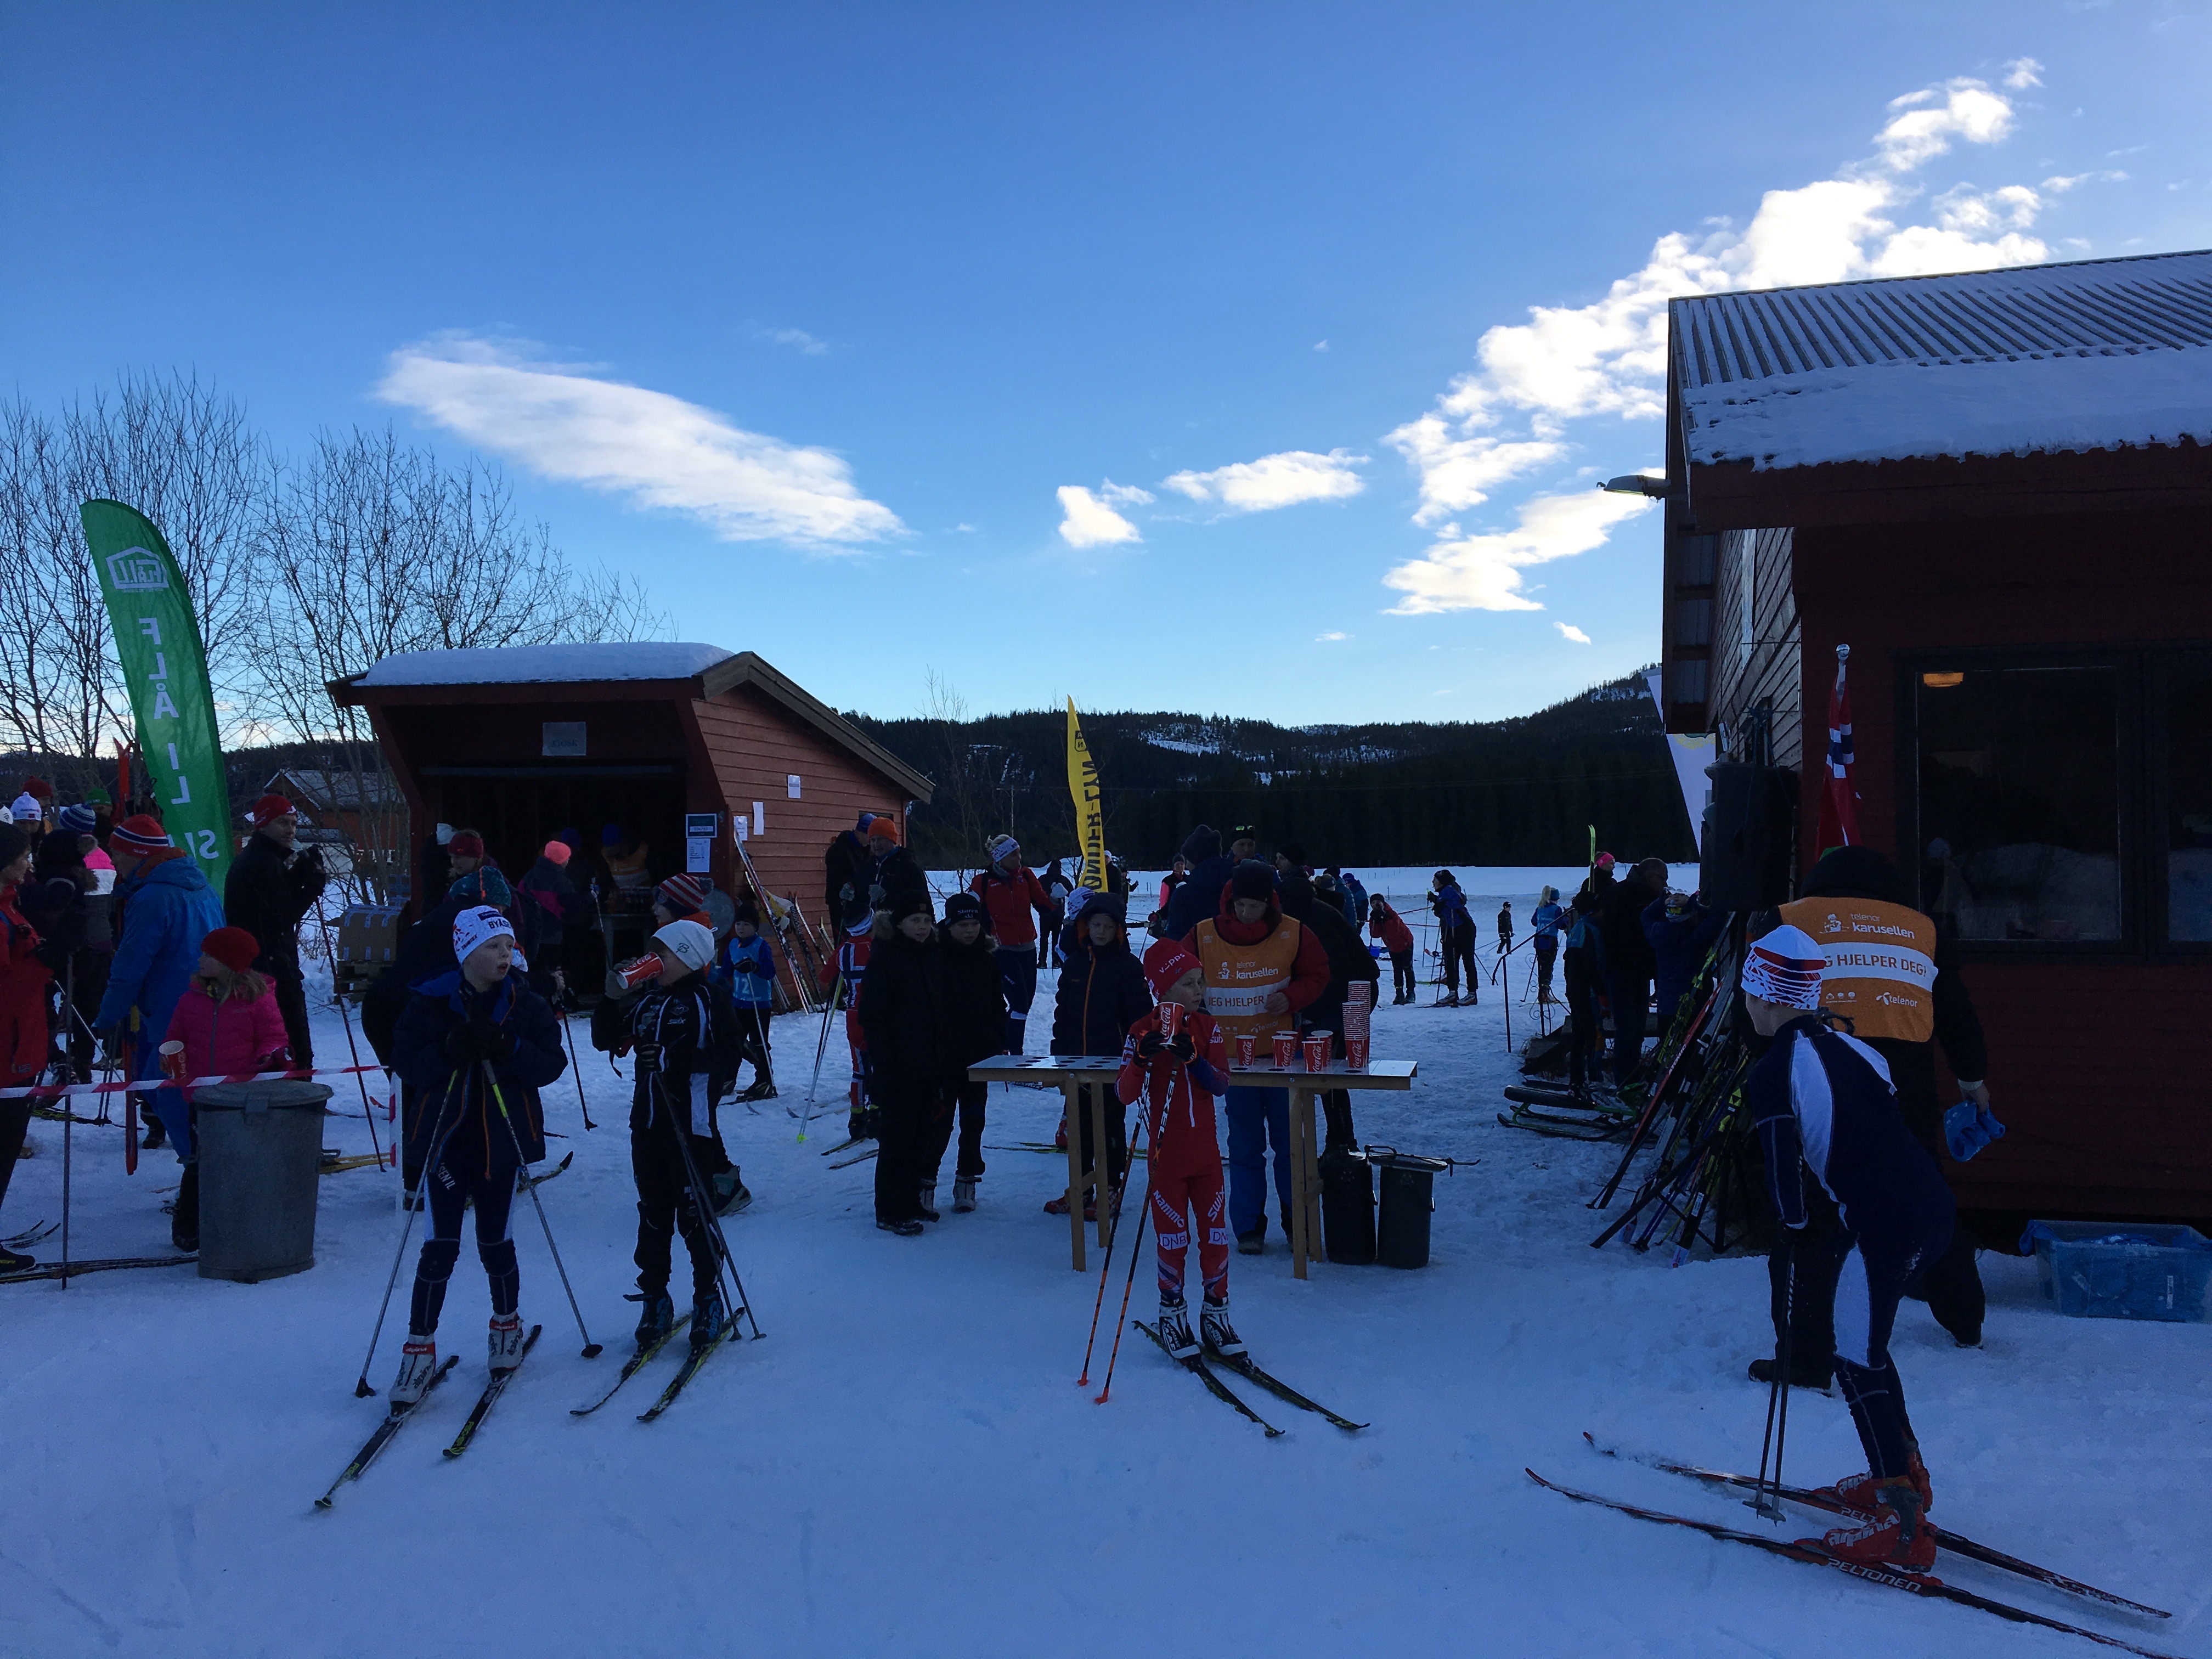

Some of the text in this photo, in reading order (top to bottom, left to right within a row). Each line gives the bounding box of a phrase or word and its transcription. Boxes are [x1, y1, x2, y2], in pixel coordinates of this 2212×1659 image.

[1850, 912, 1881, 922] telenor
[1852, 922, 1915, 939] karusellen
[1837, 953, 1898, 969] HJELPER
[1235, 967, 1279, 980] karusellen
[1208, 995, 1265, 1007] JEG HJELPER
[1888, 995, 1918, 1007] telenor
[1162, 1234, 1187, 1249] DNB
[1212, 1231, 1228, 1245] DN
[1840, 1505, 1877, 1525] PELT
[1828, 1557, 1922, 1593] PELTONEN
